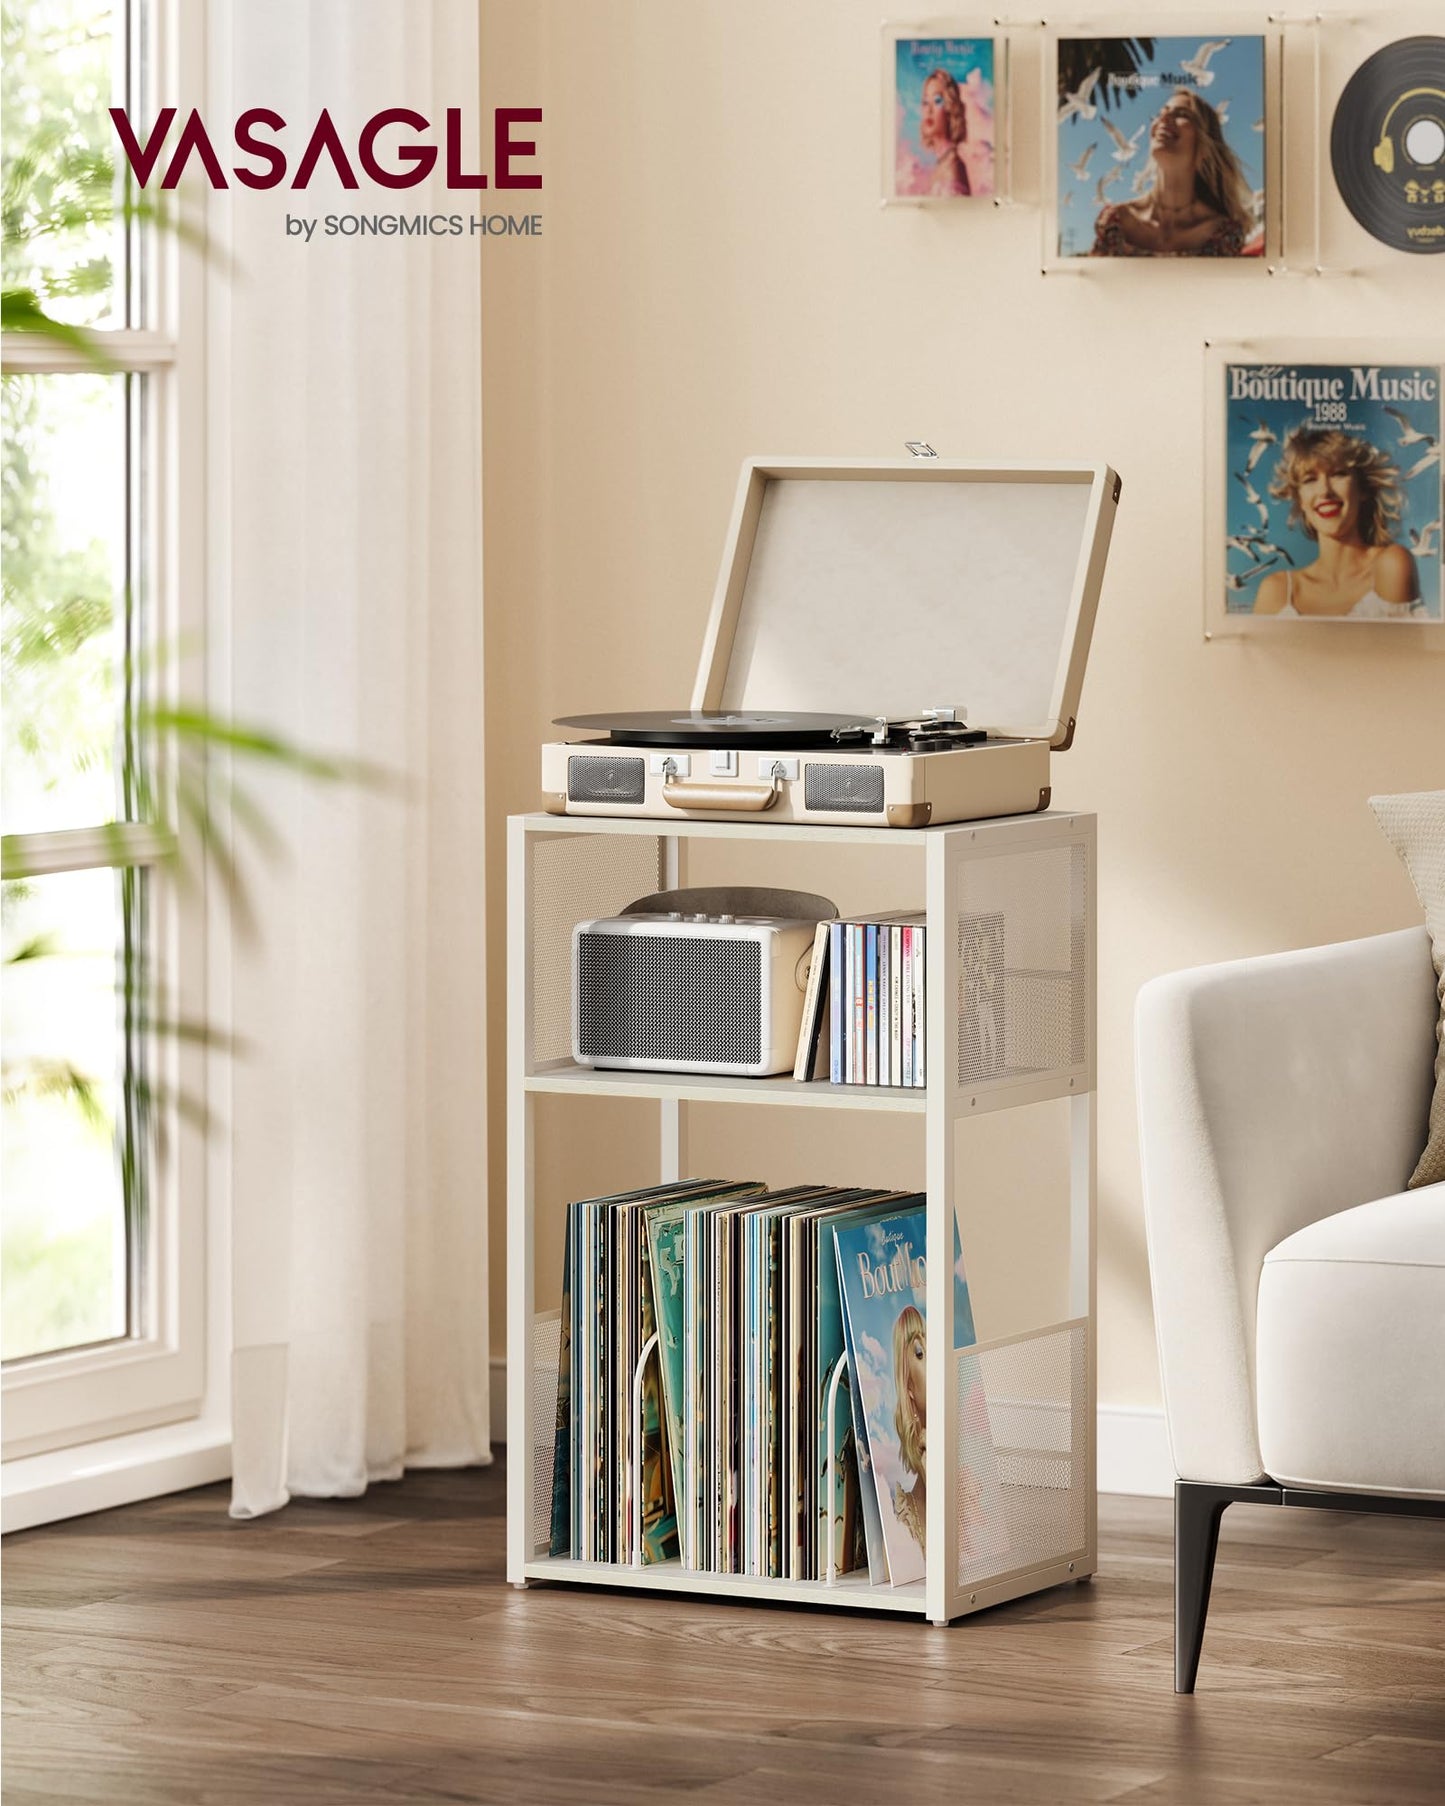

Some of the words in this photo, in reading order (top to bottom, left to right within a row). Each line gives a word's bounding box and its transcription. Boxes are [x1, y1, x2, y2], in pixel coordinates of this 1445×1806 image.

[1230, 367, 1344, 408] Boutique
[1350, 368, 1436, 401] Music
[1314, 403, 1347, 422] 1988
